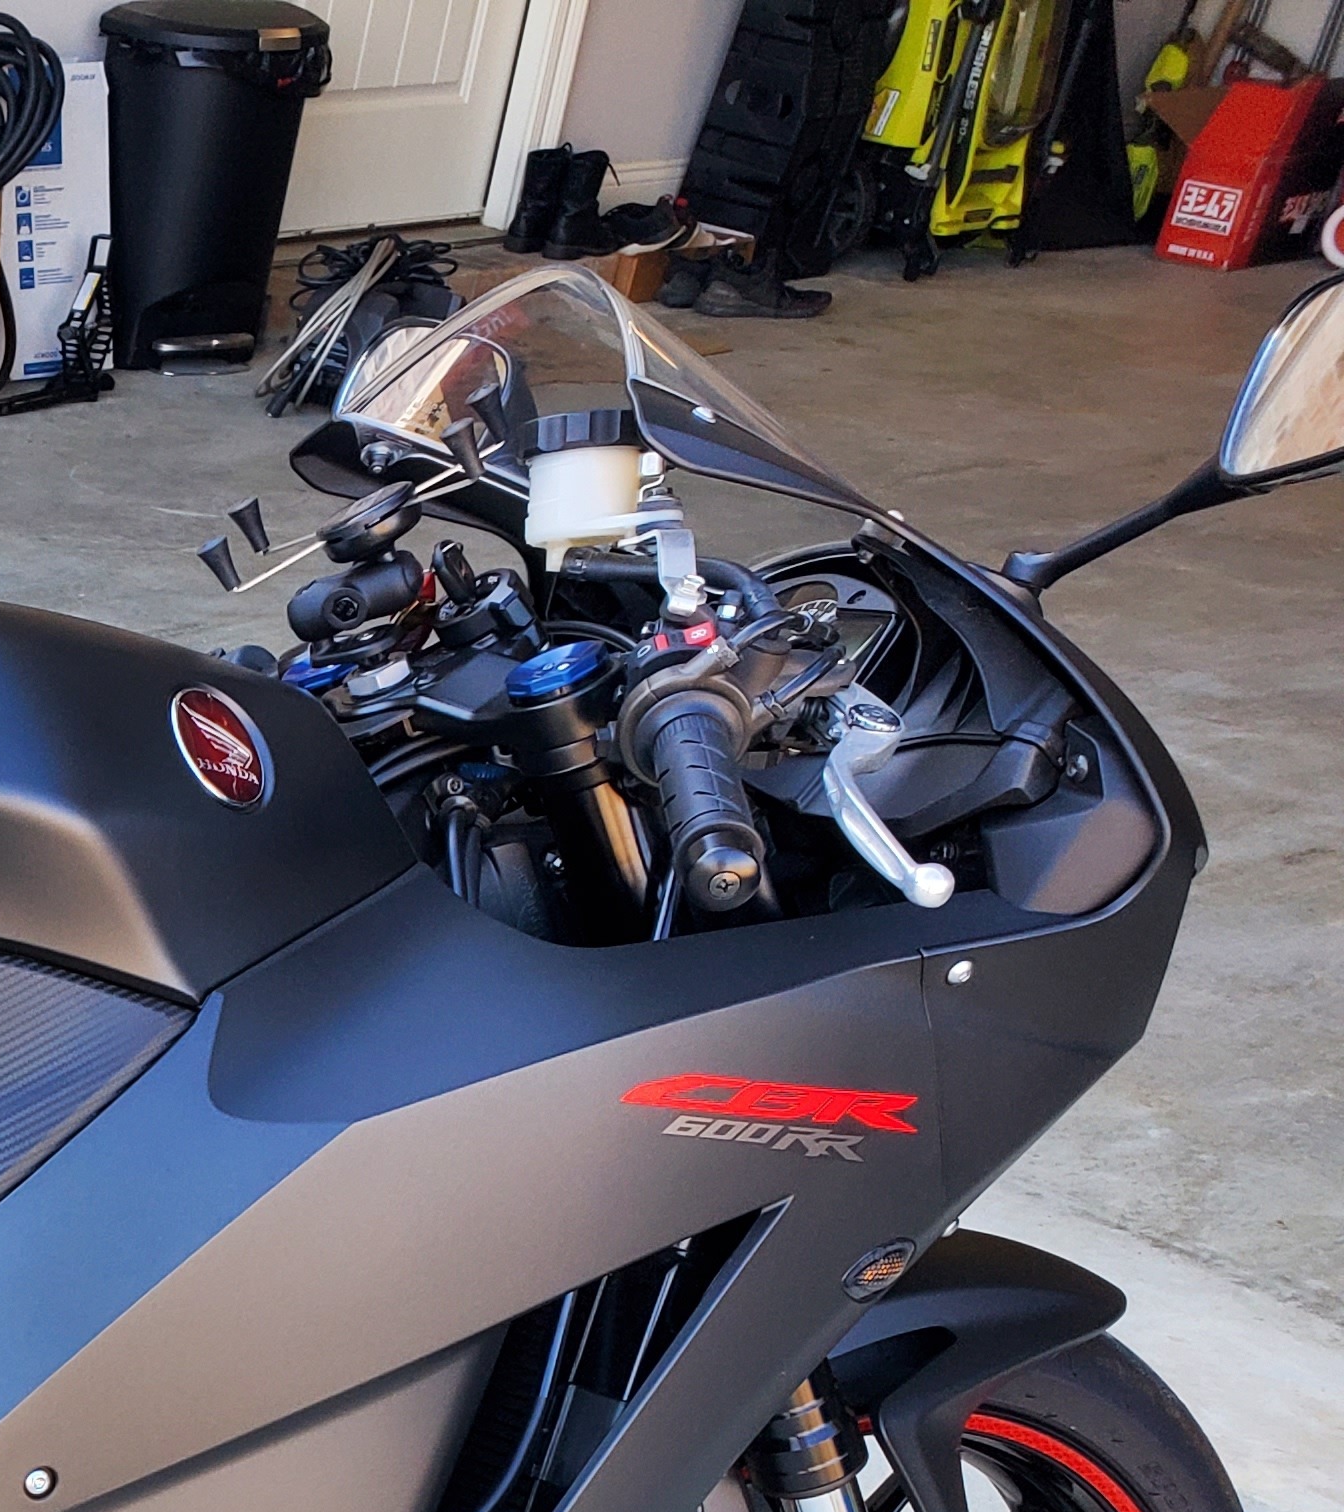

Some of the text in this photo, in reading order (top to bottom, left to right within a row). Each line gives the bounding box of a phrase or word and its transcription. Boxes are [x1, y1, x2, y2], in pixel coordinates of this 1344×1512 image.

[197, 757, 260, 786] HONDA
[619, 1072, 919, 1135] CBR
[661, 1114, 865, 1163] 600RR
